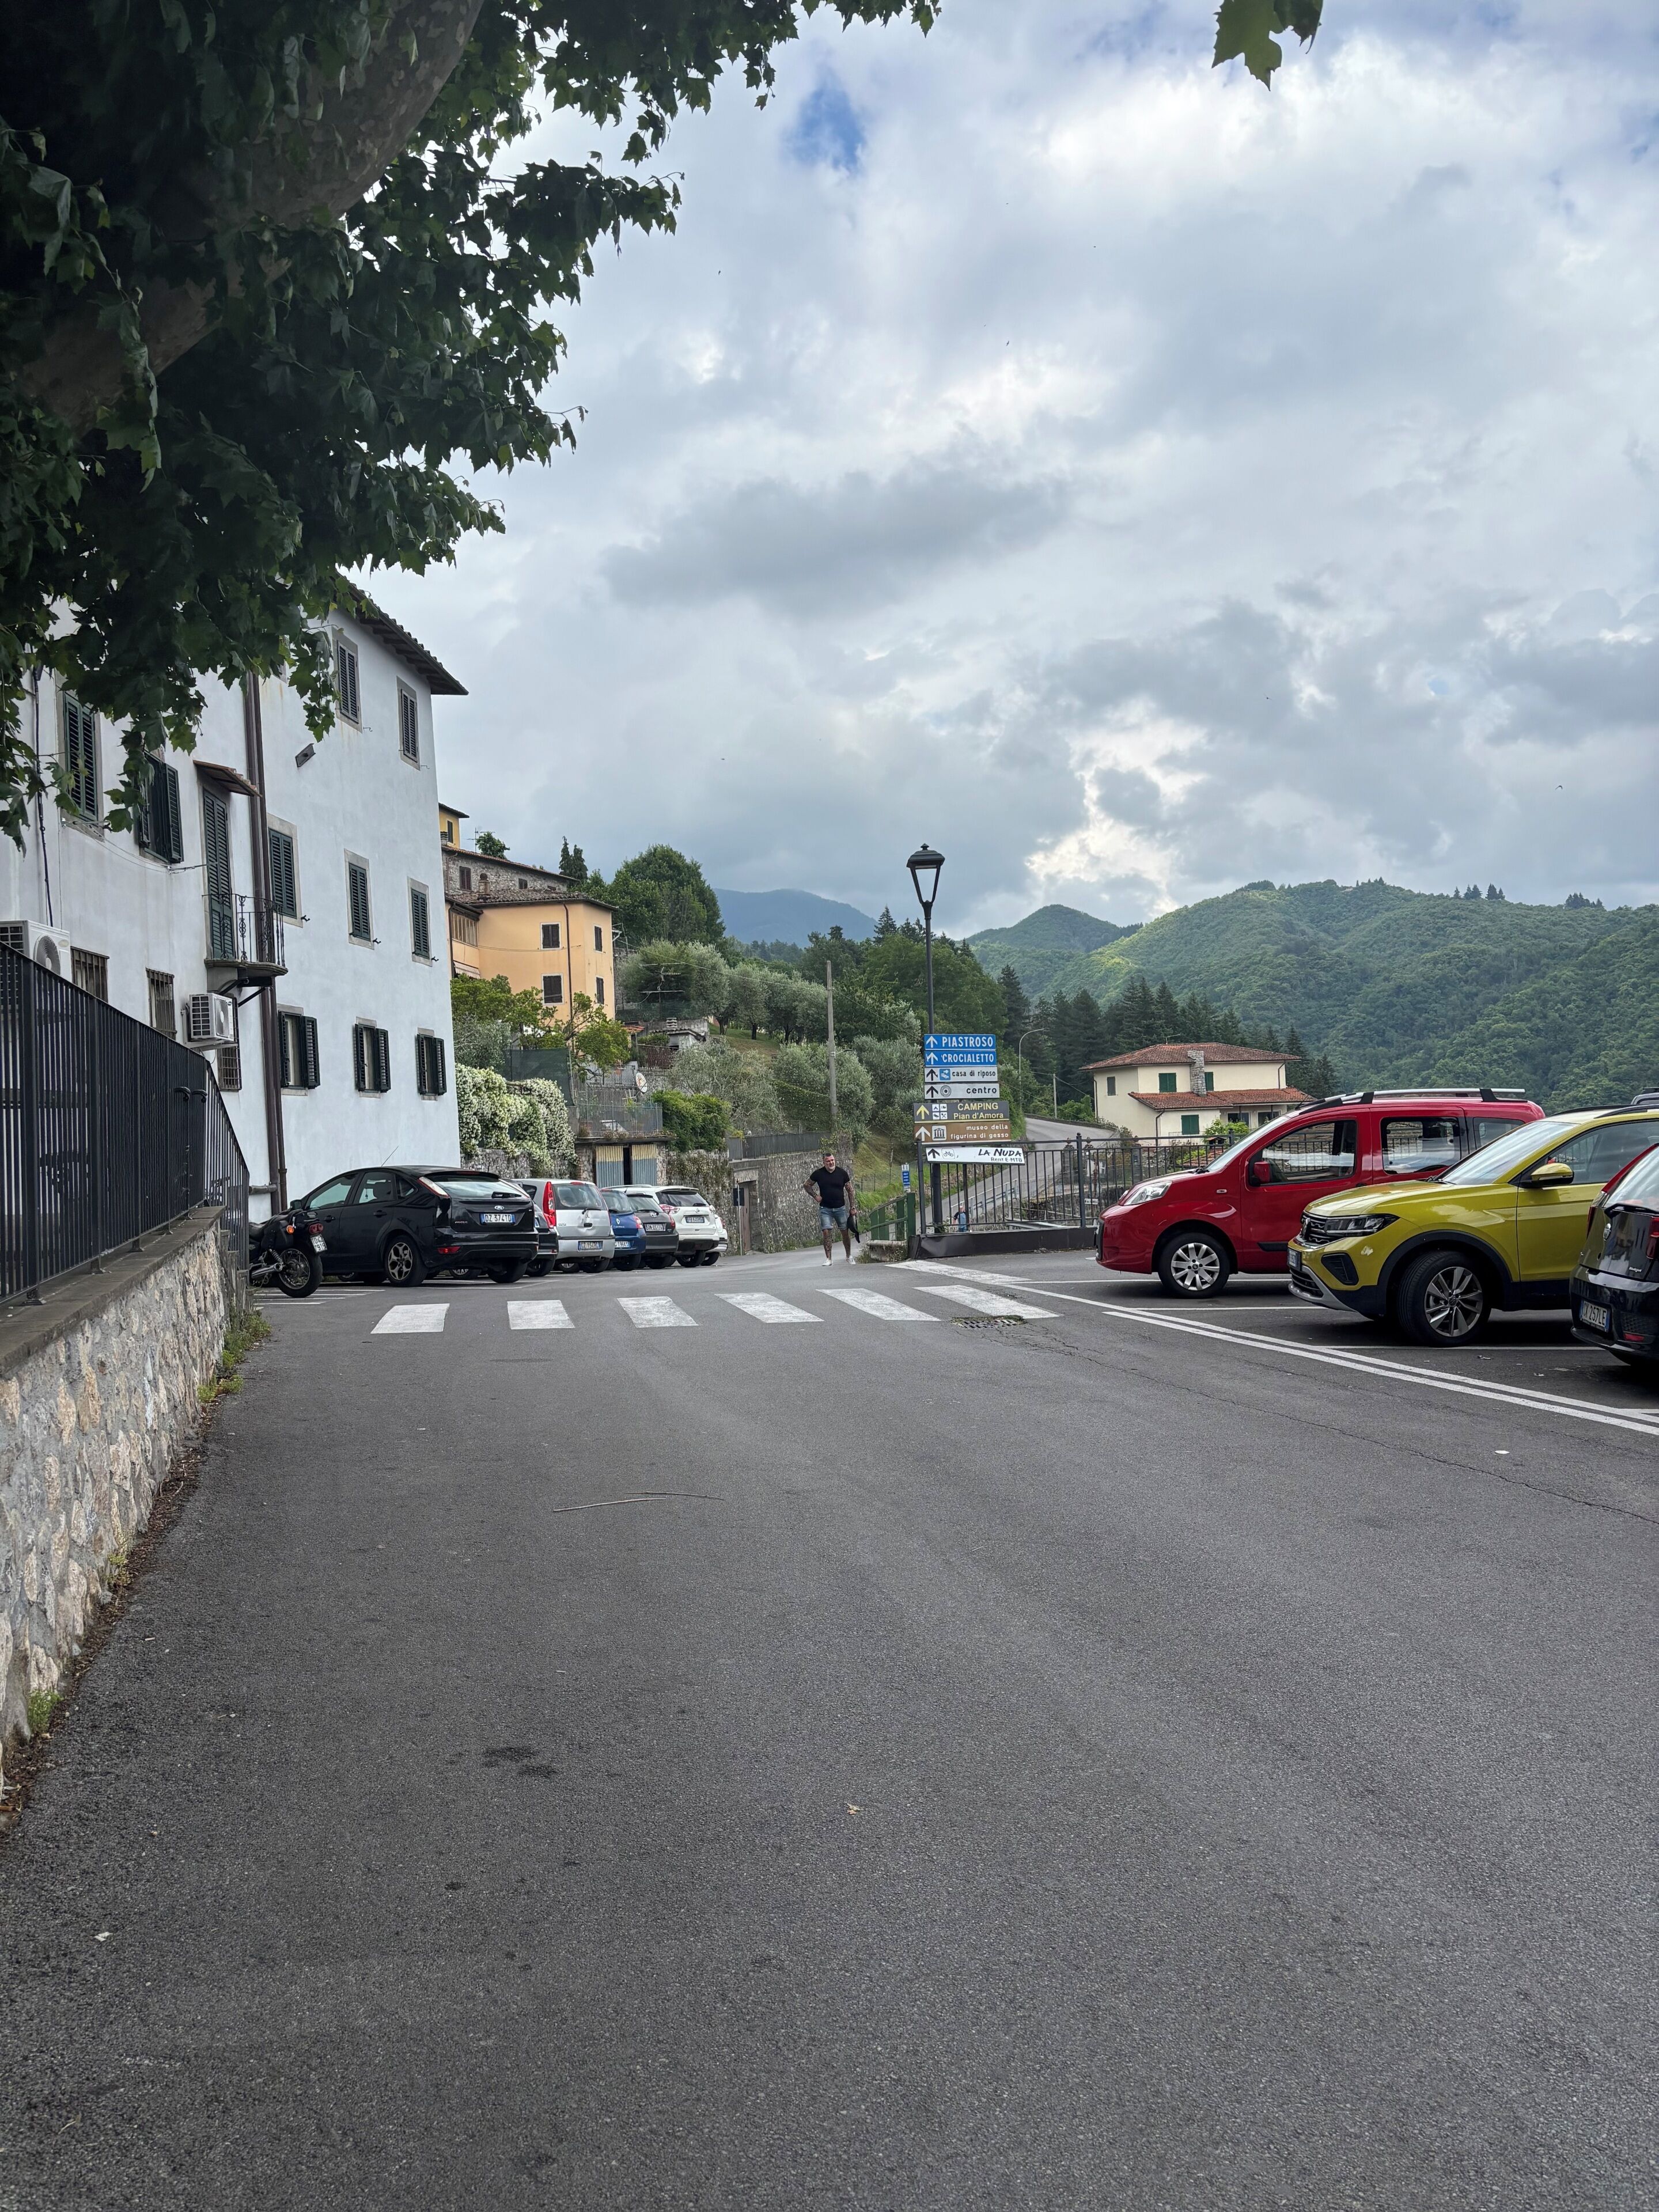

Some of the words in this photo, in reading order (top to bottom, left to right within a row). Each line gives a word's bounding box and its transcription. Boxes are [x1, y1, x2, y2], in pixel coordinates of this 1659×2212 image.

[942, 1036, 993, 1047] PIASTROSO
[942, 1054, 994, 1063] CROCIALETTO
[978, 1070, 996, 1078] riposo
[957, 1103, 999, 1111] CAMPING
[993, 1149, 1022, 1157] NUDA
[1589, 1304, 1607, 1325] 257LE
